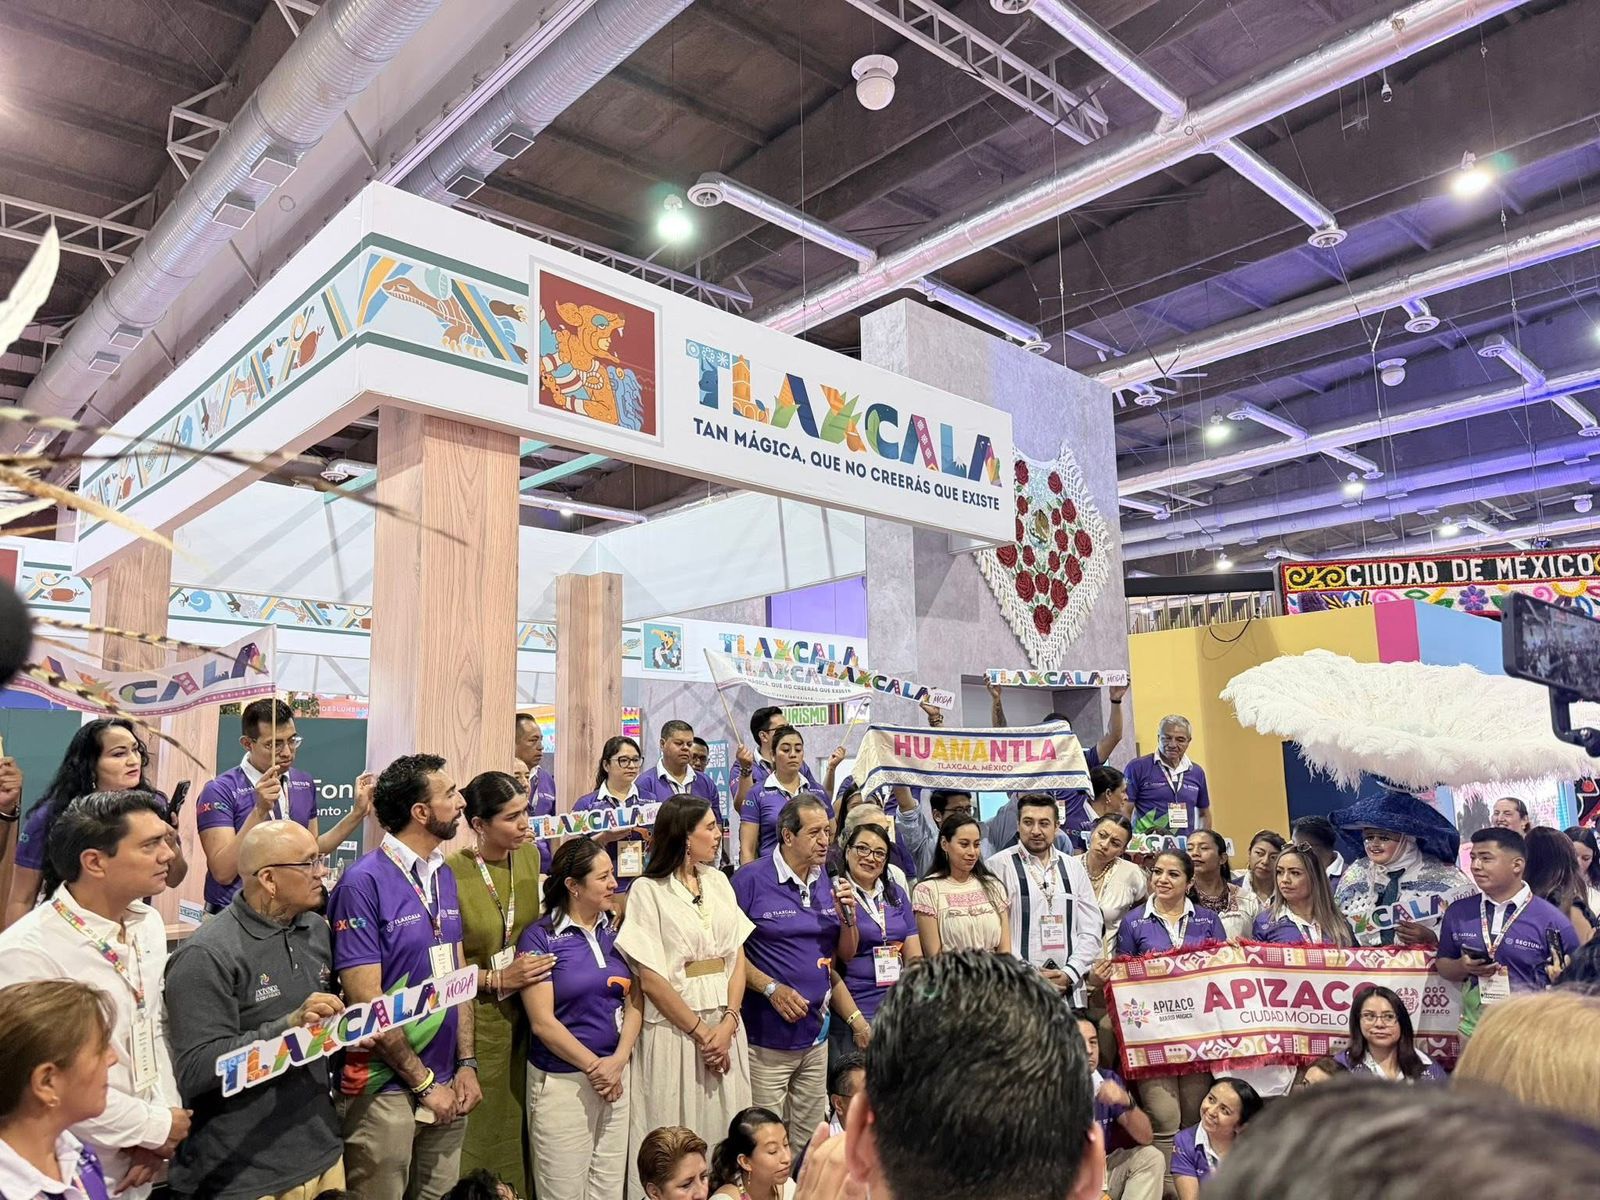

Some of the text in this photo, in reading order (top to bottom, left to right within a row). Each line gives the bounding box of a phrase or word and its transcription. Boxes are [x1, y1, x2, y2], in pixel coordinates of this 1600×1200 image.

[686, 338, 1002, 488] TLAXCALA
[693, 417, 1000, 511] TAN MÁGICA, QUE NO CREERÁS QUE EXISTE
[1346, 552, 1595, 587] CIUDAD DE MÉXICO
[719, 633, 859, 668] TLAXCALA
[817, 658, 932, 703] TLAXCALA
[990, 671, 1104, 687] TLAXCALA
[894, 734, 1056, 763] HUAMANTLA
[981, 763, 1013, 772] MÉXICO
[532, 807, 644, 838] TLAXCALA
[445, 973, 474, 1003] MODA
[1153, 997, 1195, 1013] APIZACO
[1240, 1010, 1348, 1026] CIUDAD MODELO
[218, 982, 440, 1093] TLAXCALA
